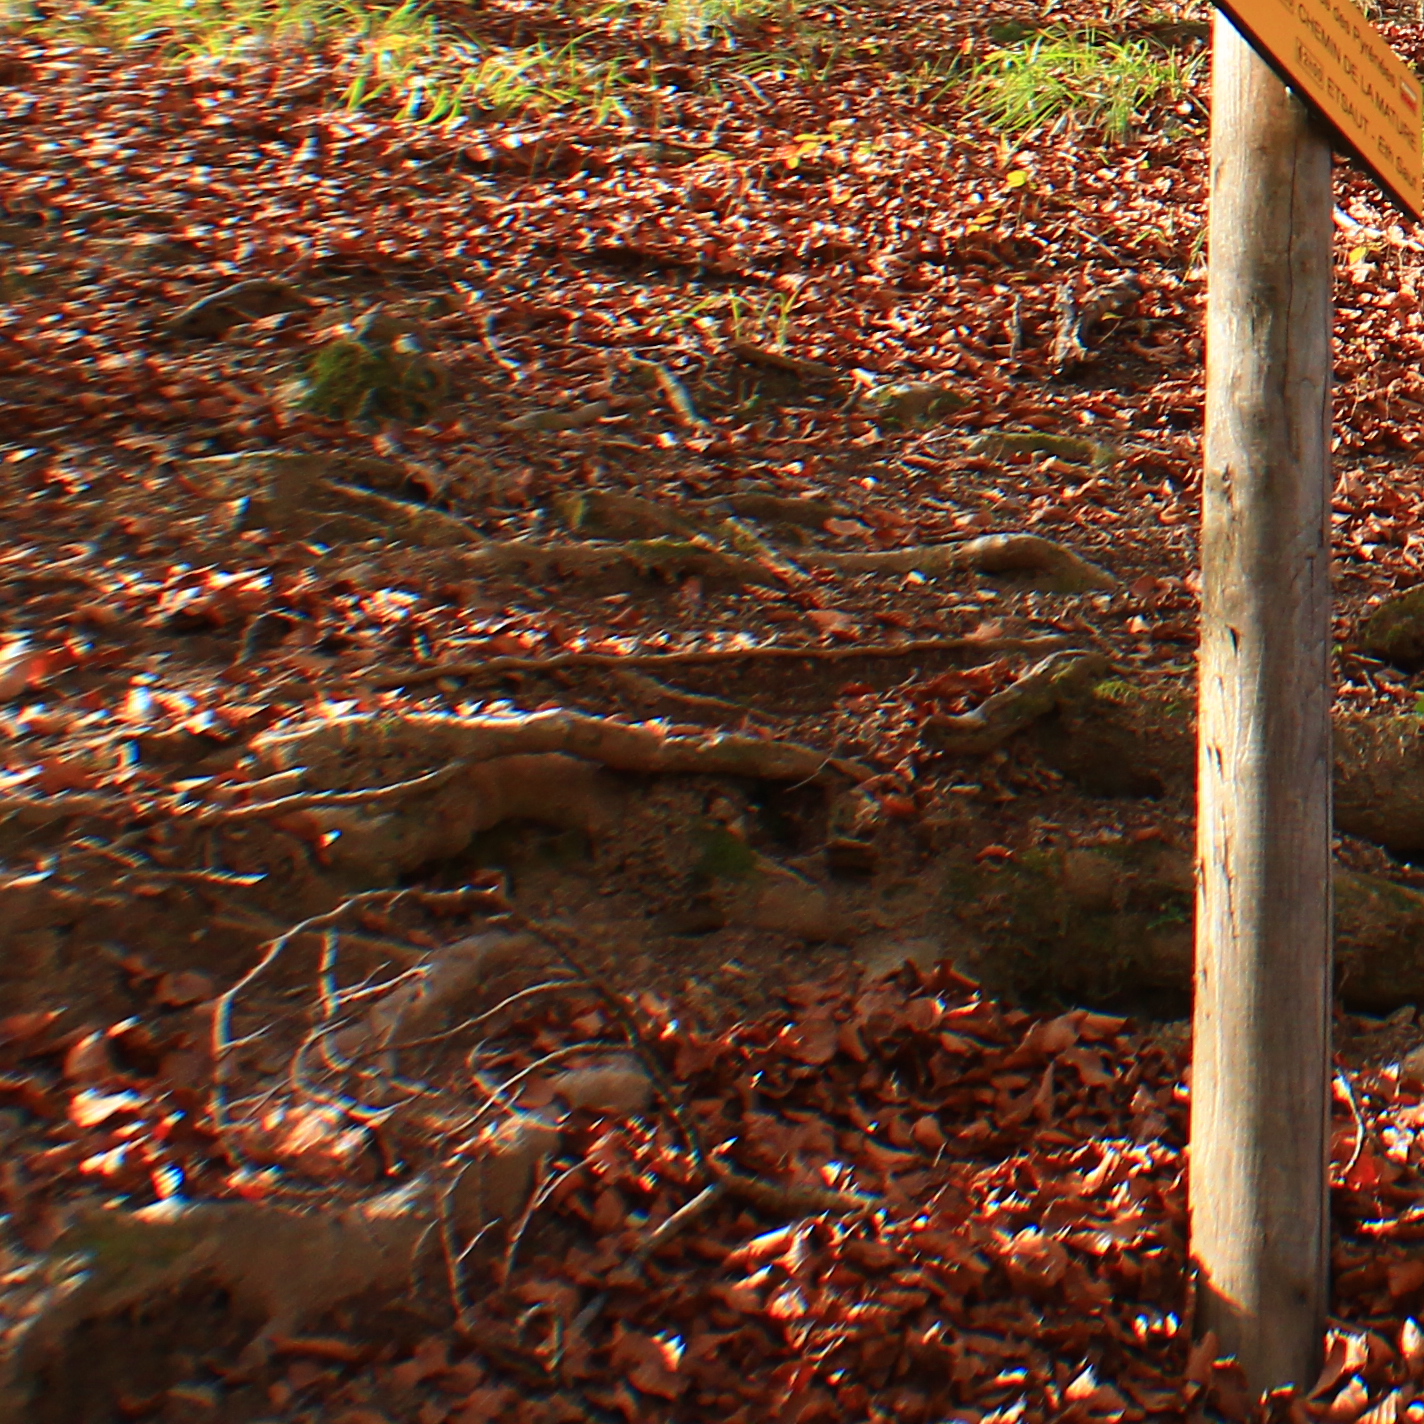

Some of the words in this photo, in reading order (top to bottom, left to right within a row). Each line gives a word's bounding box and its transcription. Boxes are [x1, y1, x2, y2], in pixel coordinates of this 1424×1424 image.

[1298, 3, 1341, 64] CHEMIN
[1343, 55, 1359, 86] DE
[1361, 75, 1375, 102] LA
[1327, 76, 1369, 135] ETSAUT
